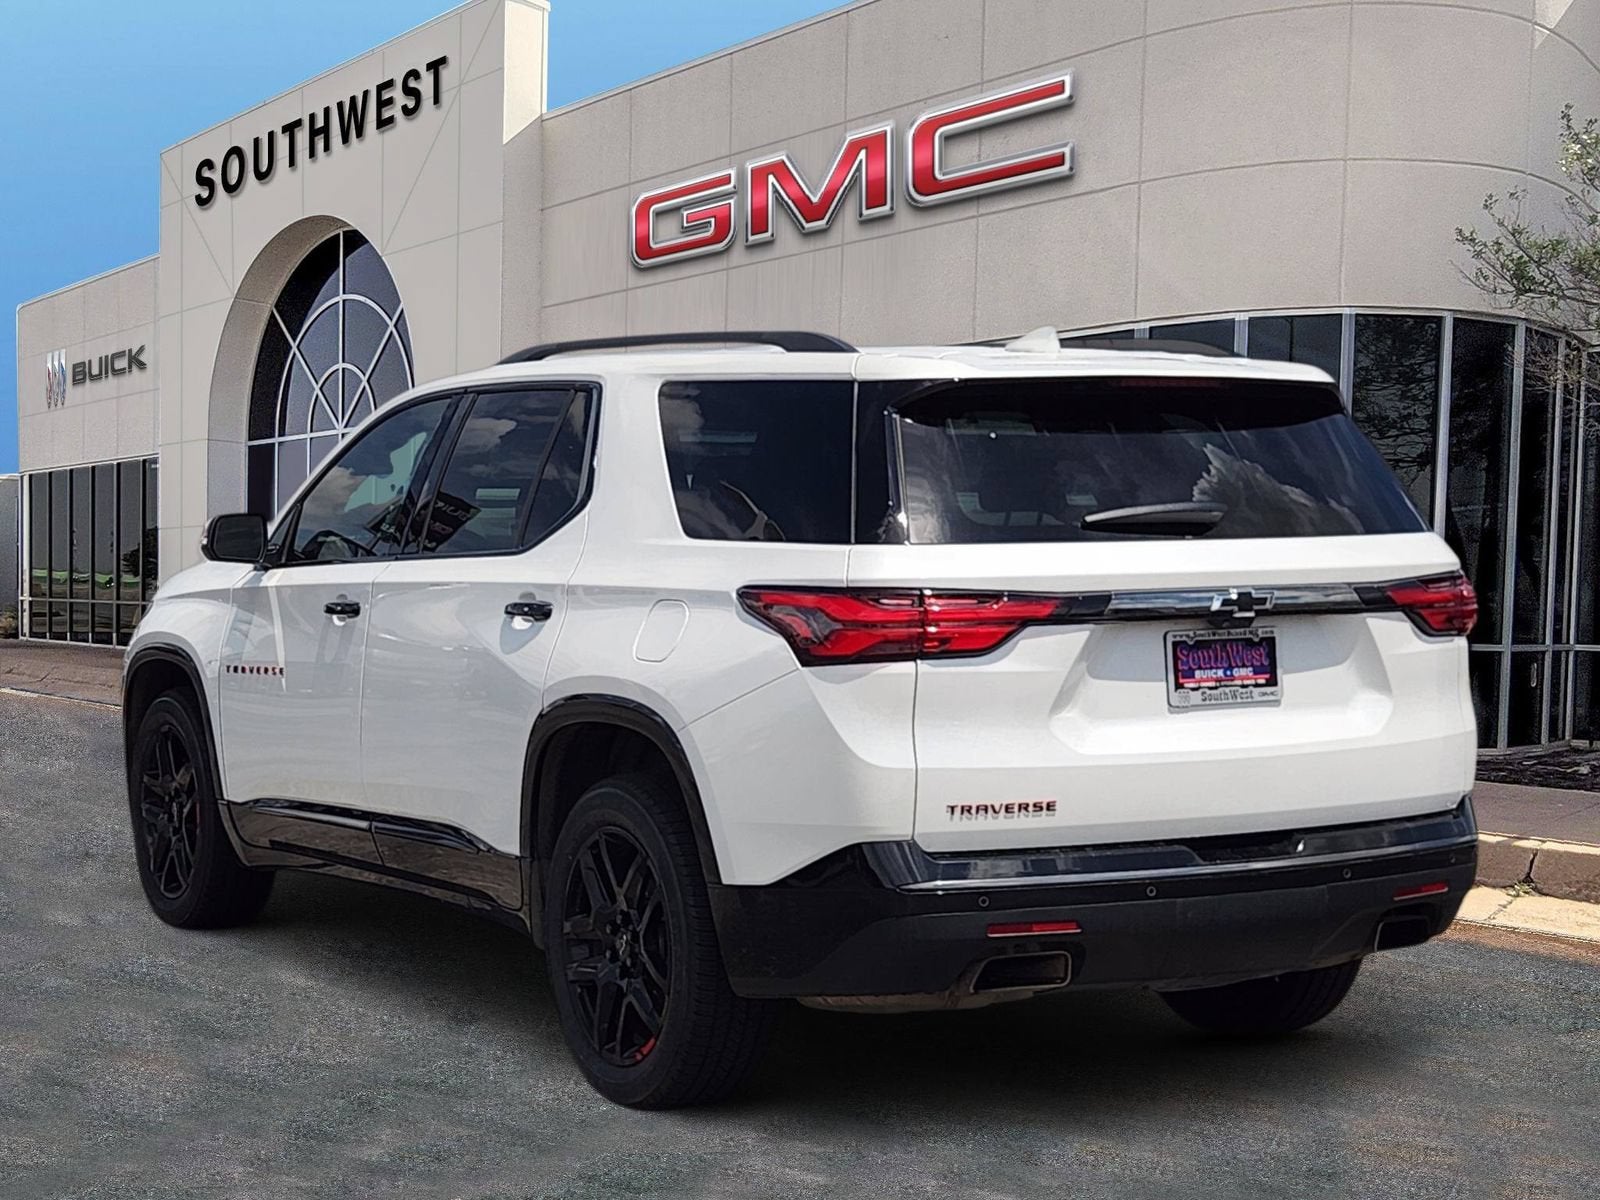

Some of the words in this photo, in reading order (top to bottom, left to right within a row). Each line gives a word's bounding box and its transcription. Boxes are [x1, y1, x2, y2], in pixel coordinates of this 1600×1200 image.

[194, 56, 449, 206] SOUTHWEST
[630, 67, 1075, 268] GMC
[72, 344, 147, 385] BUICK
[1194, 669, 1224, 679] BUICK
[1232, 667, 1254, 677] GMC
[946, 800, 1057, 816] TRAVERSE
